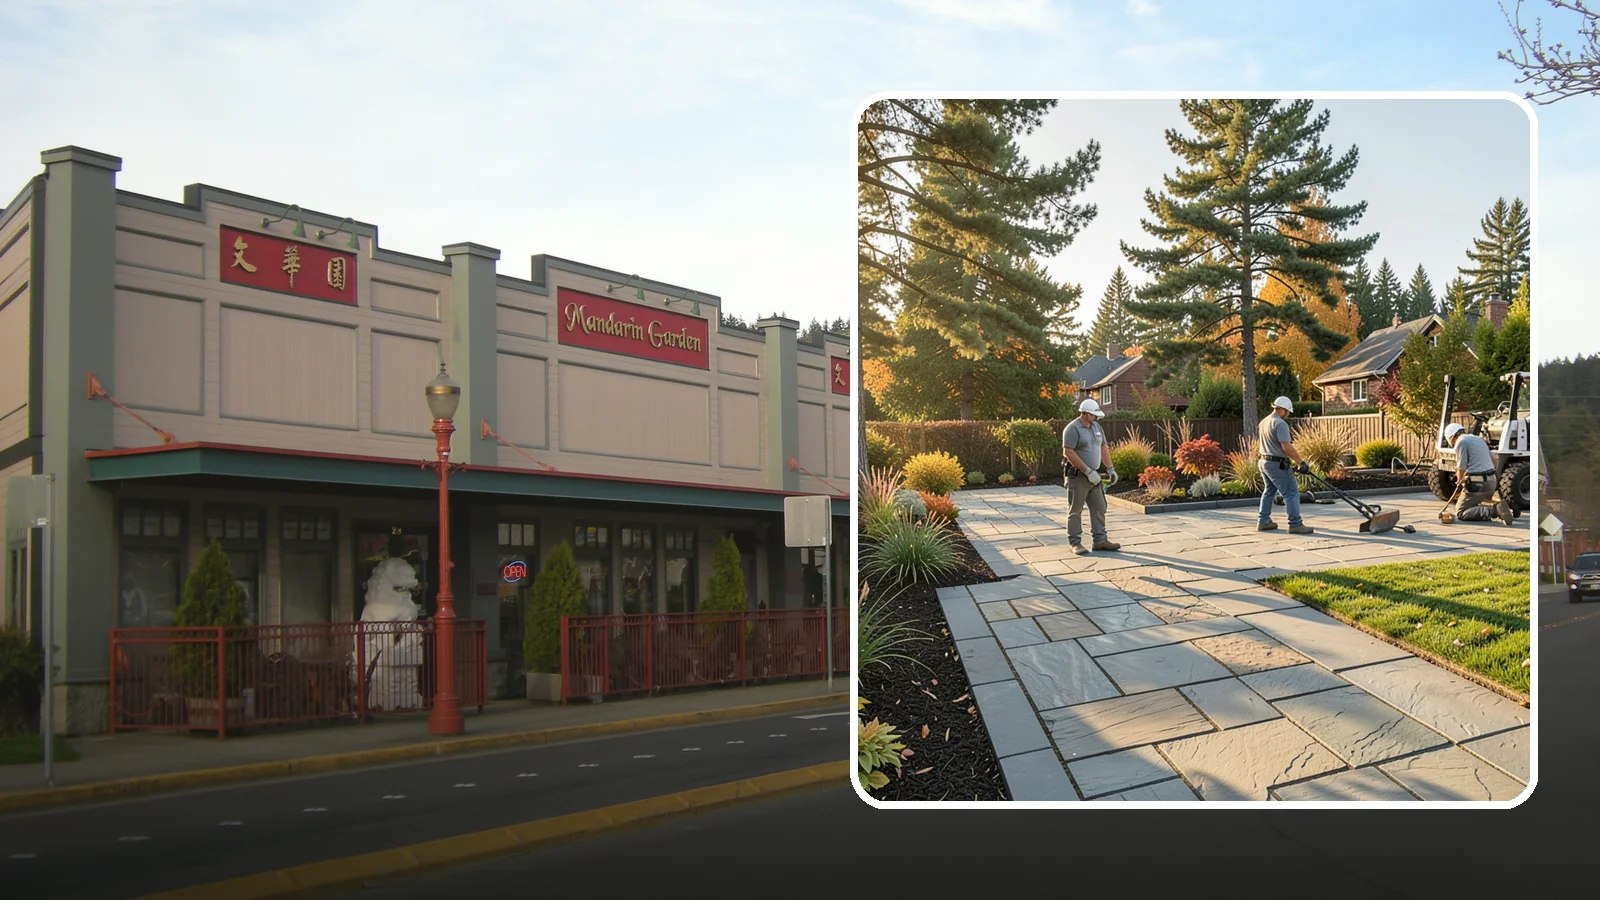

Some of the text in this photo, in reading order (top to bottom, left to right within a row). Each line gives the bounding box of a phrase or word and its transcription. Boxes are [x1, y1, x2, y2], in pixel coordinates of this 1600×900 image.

[230, 235, 346, 291] 文華園
[564, 302, 702, 352] Mandarin Garden
[503, 565, 527, 578] OPEN
